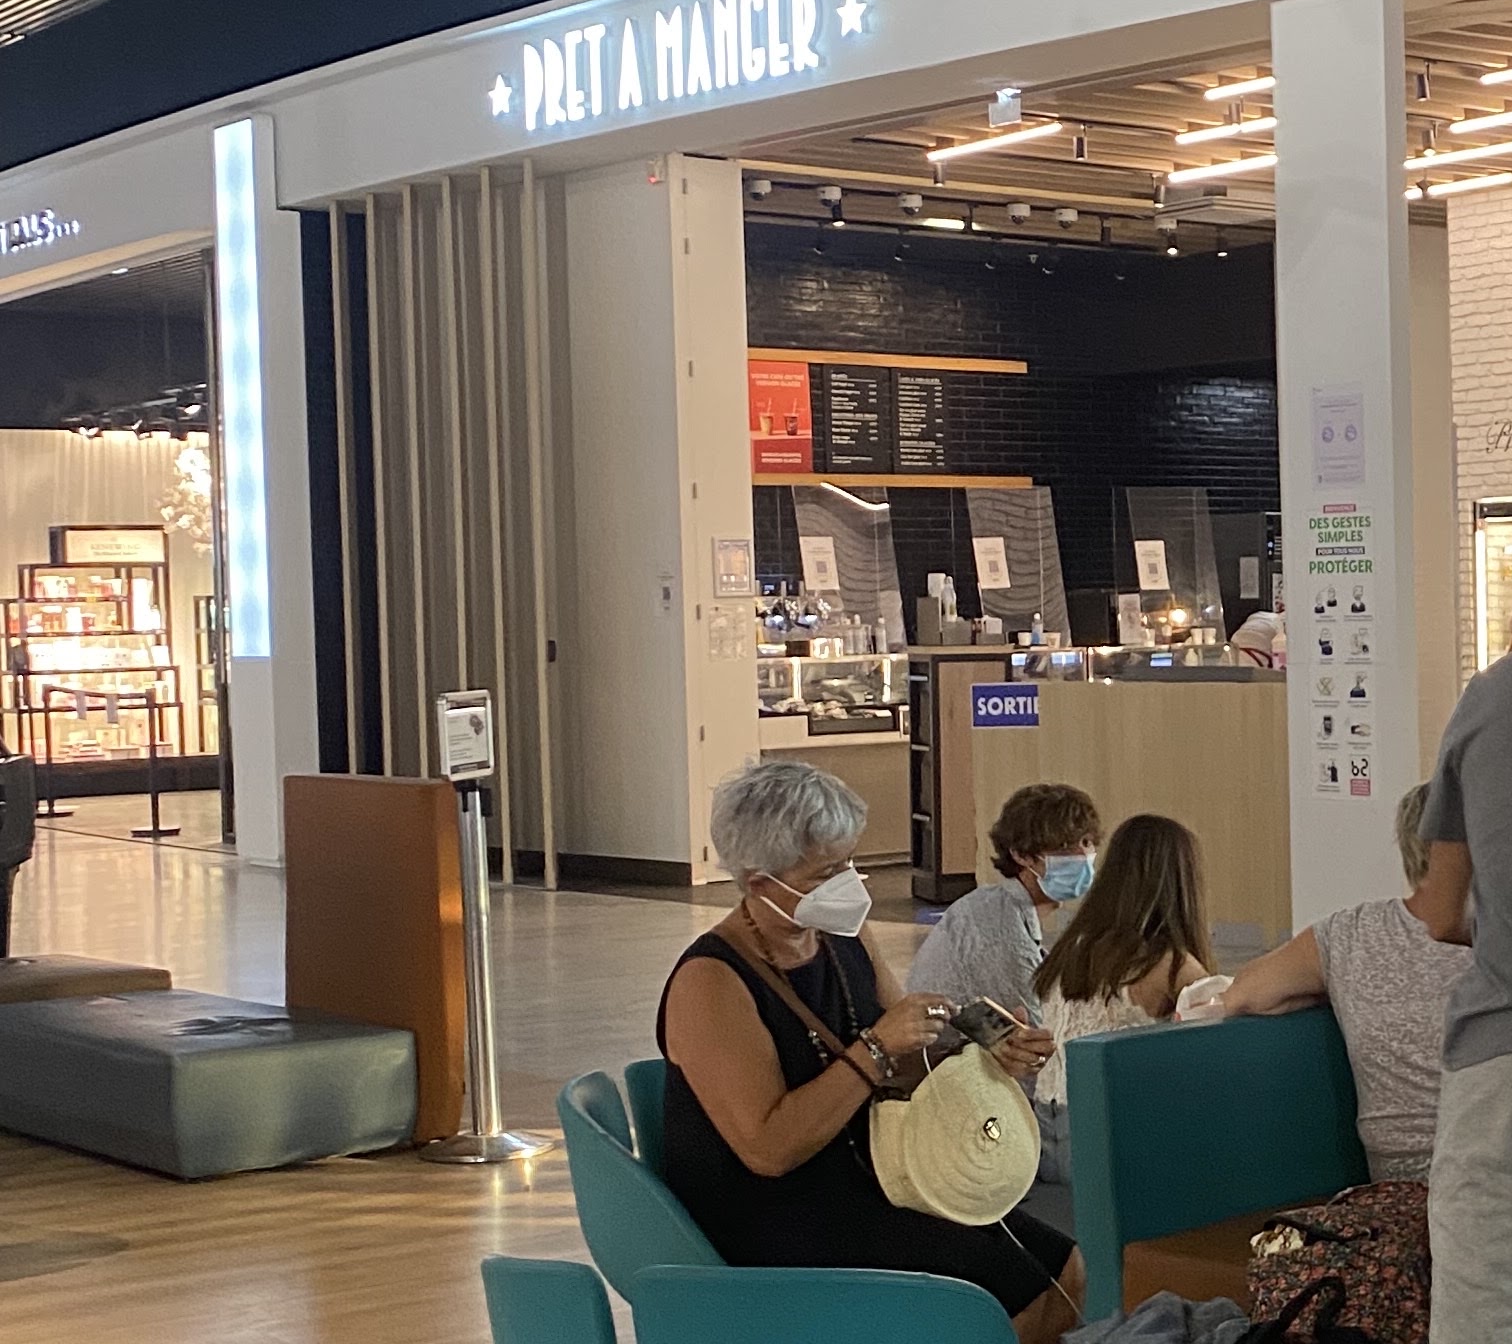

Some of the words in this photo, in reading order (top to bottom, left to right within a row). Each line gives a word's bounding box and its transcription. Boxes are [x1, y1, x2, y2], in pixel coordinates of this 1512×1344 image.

[523, 24, 605, 131] PRET
[618, 18, 643, 110] A
[1310, 518, 1329, 529] DES
[1332, 516, 1371, 528] GESTES
[1318, 530, 1363, 543] SIMPLES
[1309, 557, 1372, 574] PROTÉGER
